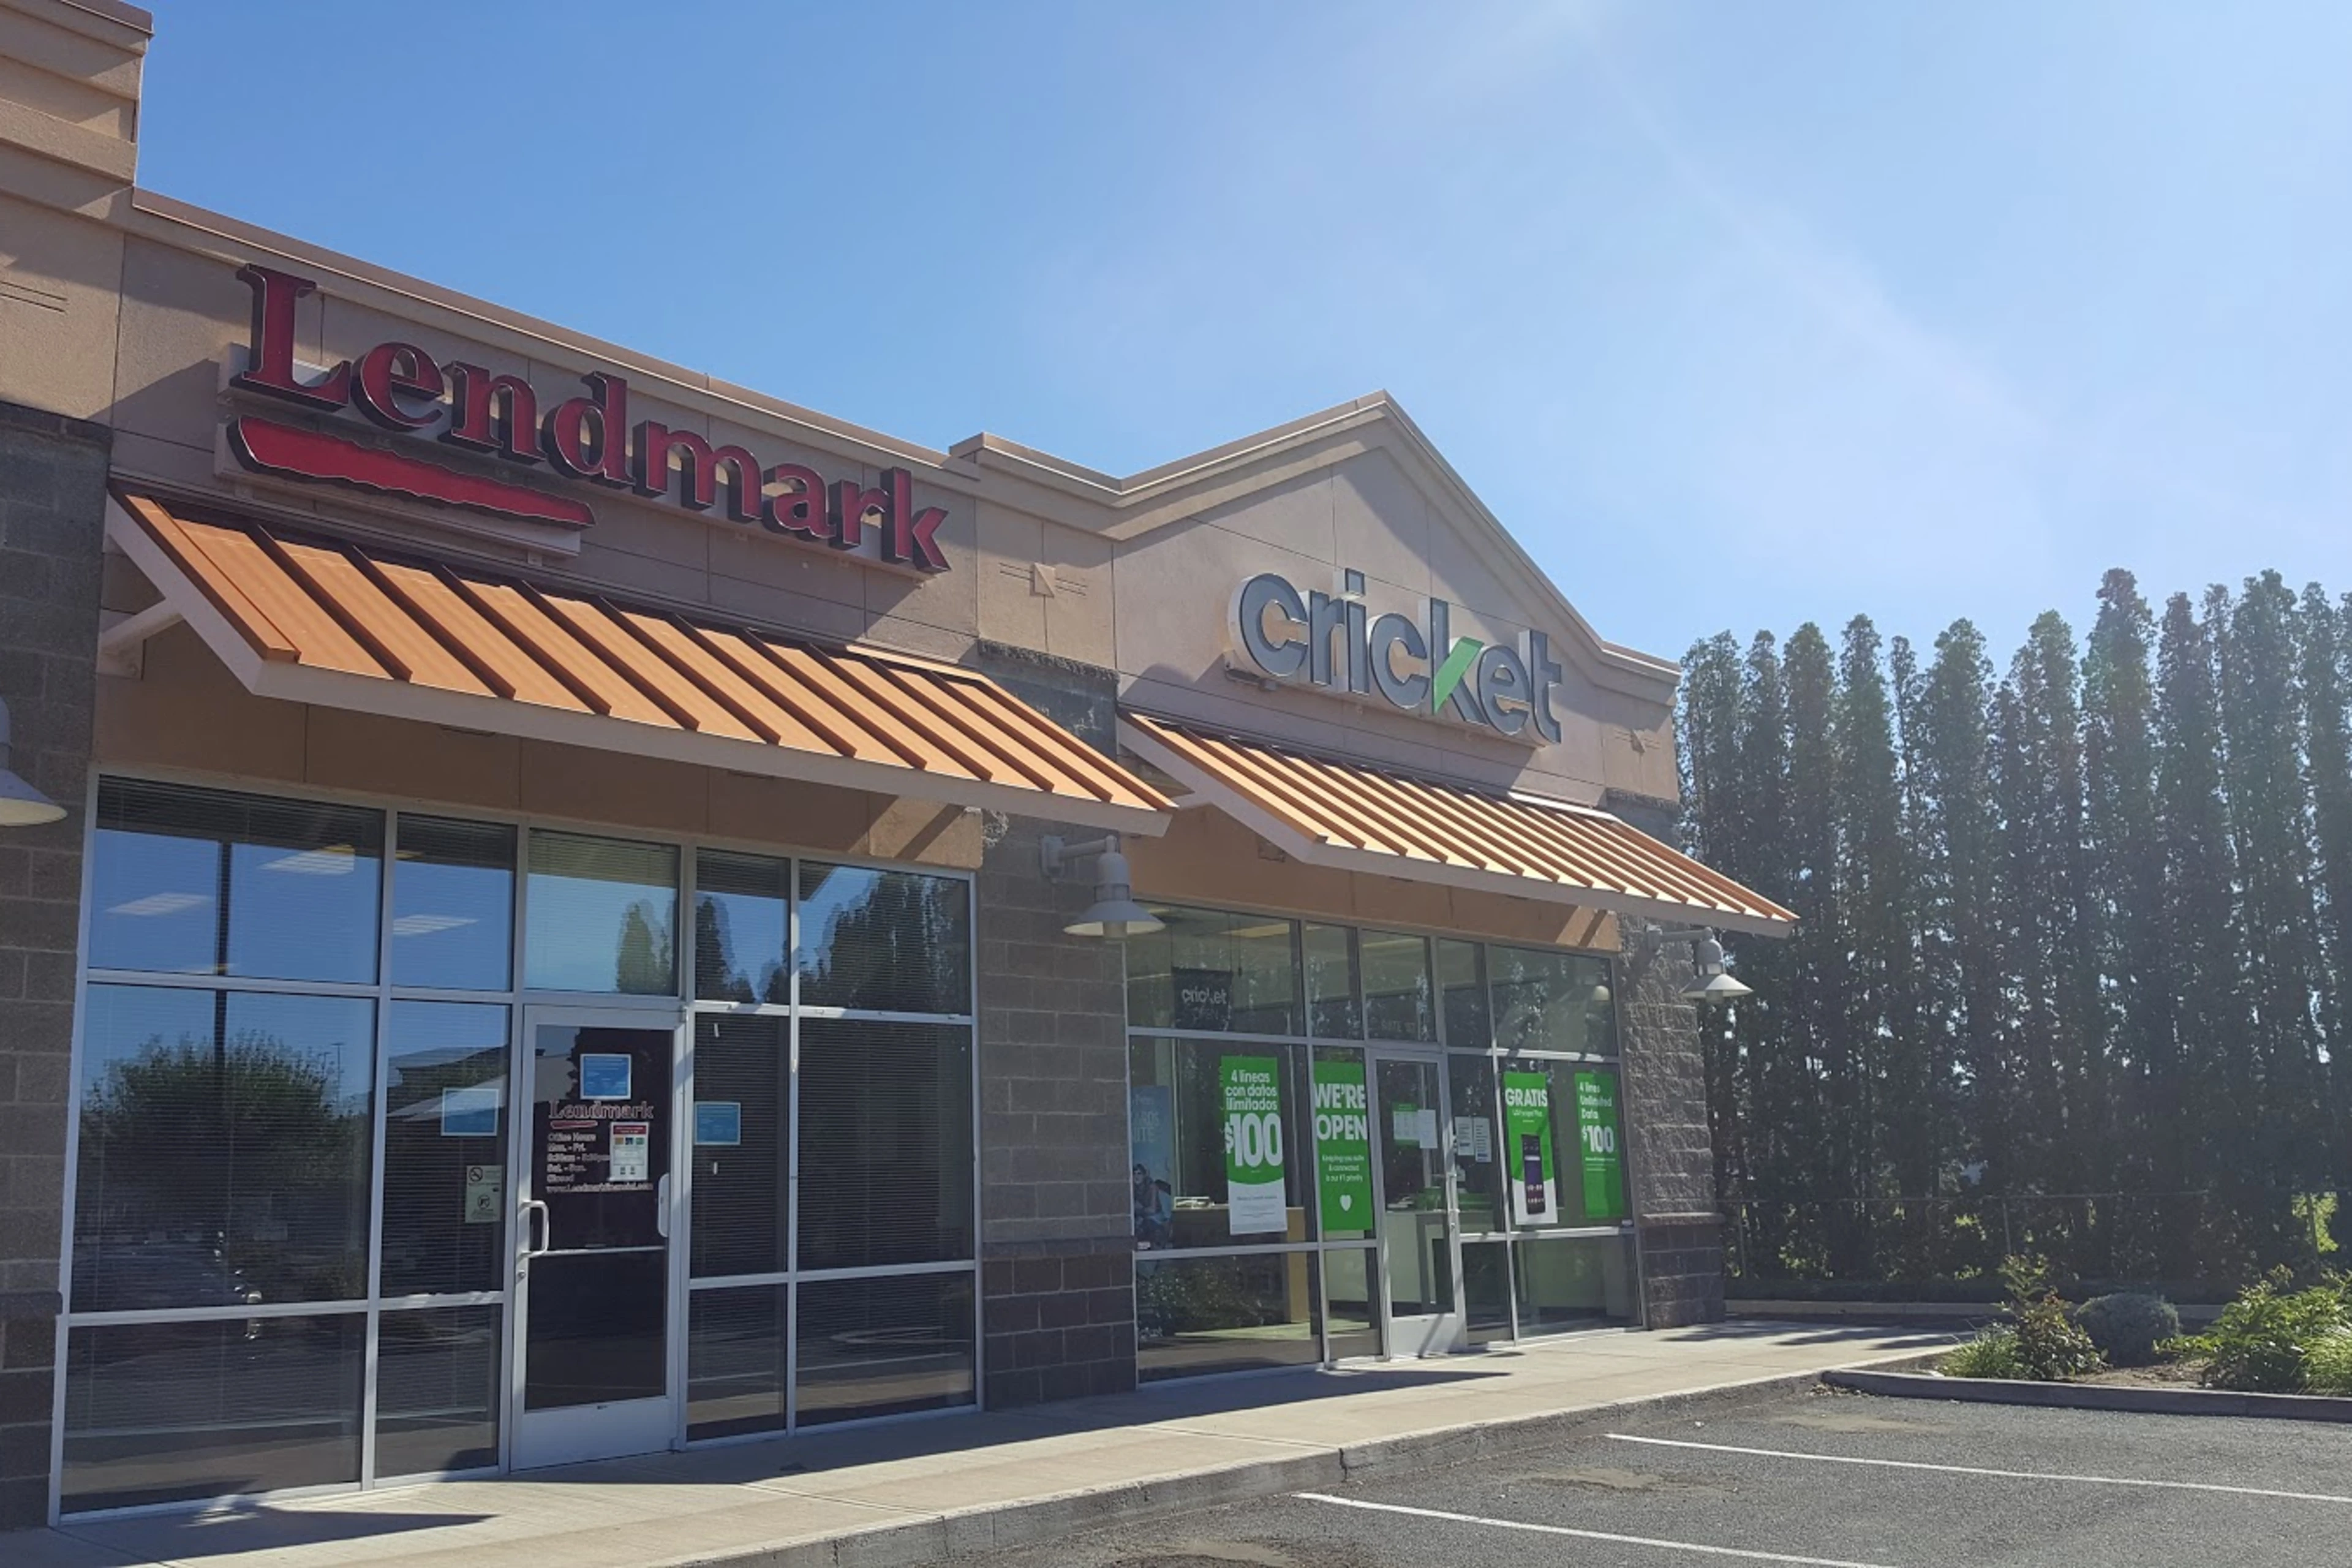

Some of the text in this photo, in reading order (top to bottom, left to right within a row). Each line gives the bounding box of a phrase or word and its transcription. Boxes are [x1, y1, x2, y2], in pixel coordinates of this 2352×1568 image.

[230, 262, 952, 573] Lendmark
[1230, 568, 1562, 744] cricket
[1231, 1069, 1237, 1083] 4
[1225, 1083, 1278, 1097] con datos
[1314, 1083, 1366, 1109] WE'RE
[1585, 1082, 1601, 1093] lines
[1226, 1097, 1278, 1110] ilimitados
[1505, 1088, 1548, 1107] GRATIS
[1580, 1095, 1613, 1107] Unlimited
[549, 1100, 654, 1119] Lendmark
[1581, 1107, 1599, 1119] Data
[1316, 1114, 1368, 1140] OPEN
[1224, 1112, 1284, 1167] $100
[1581, 1125, 1615, 1153] $100
